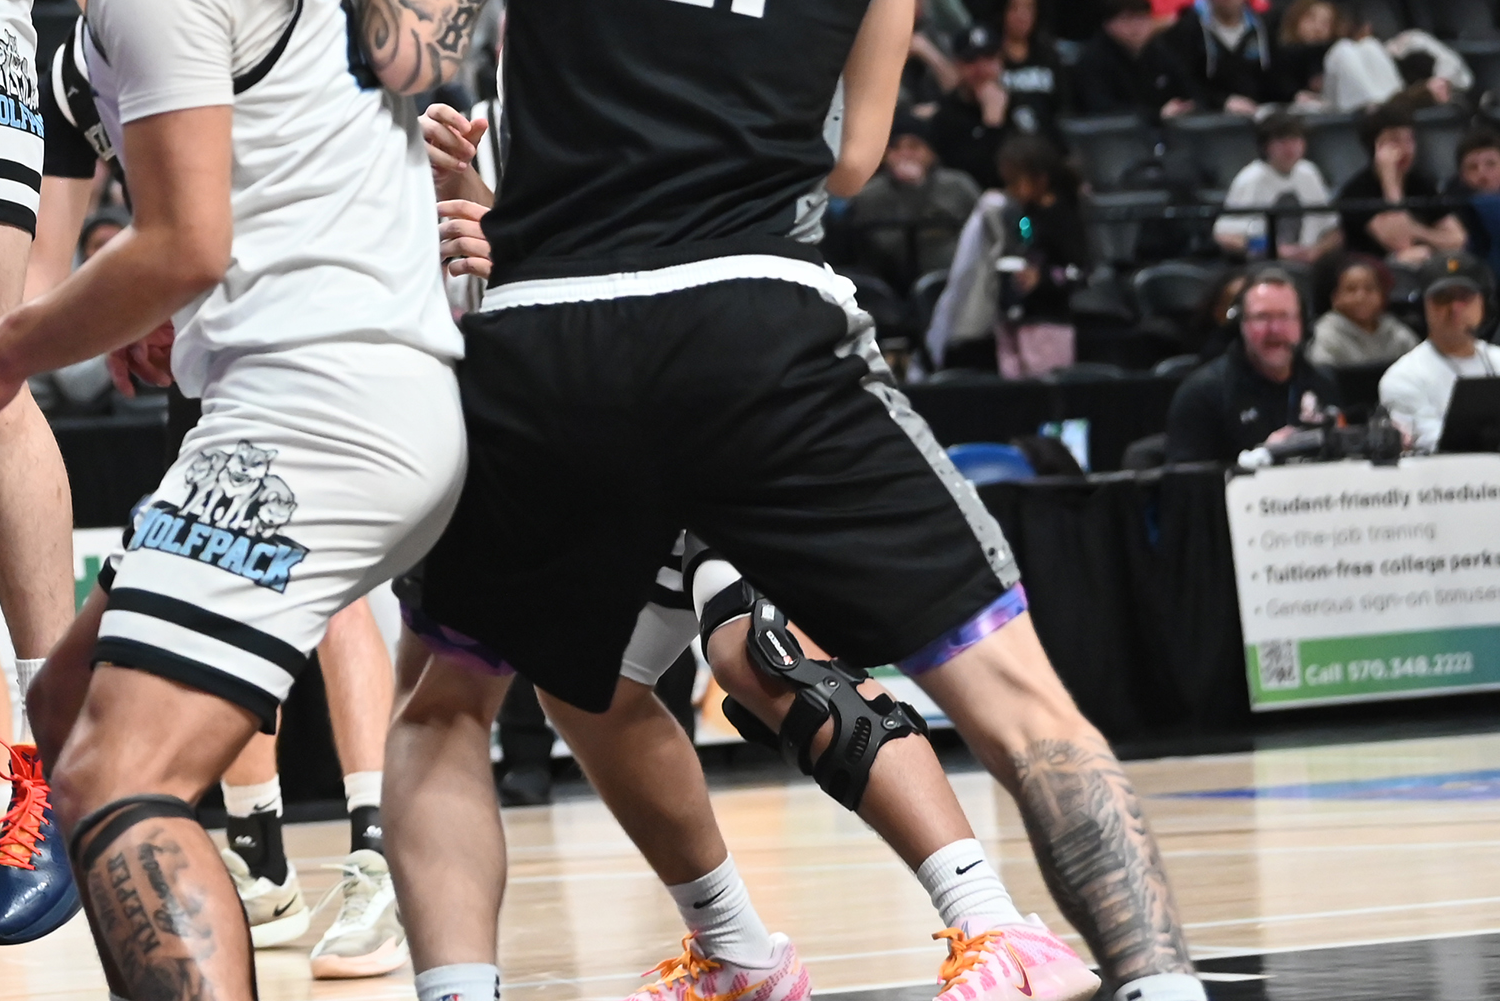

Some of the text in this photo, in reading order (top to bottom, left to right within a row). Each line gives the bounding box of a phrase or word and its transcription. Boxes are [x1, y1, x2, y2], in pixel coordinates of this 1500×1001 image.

[1259, 489, 1411, 516] Student-friendly
[1367, 521, 1437, 542] training
[1266, 559, 1374, 583] Tuition-free
[1380, 554, 1446, 575] college
[1305, 663, 1341, 685] Call
